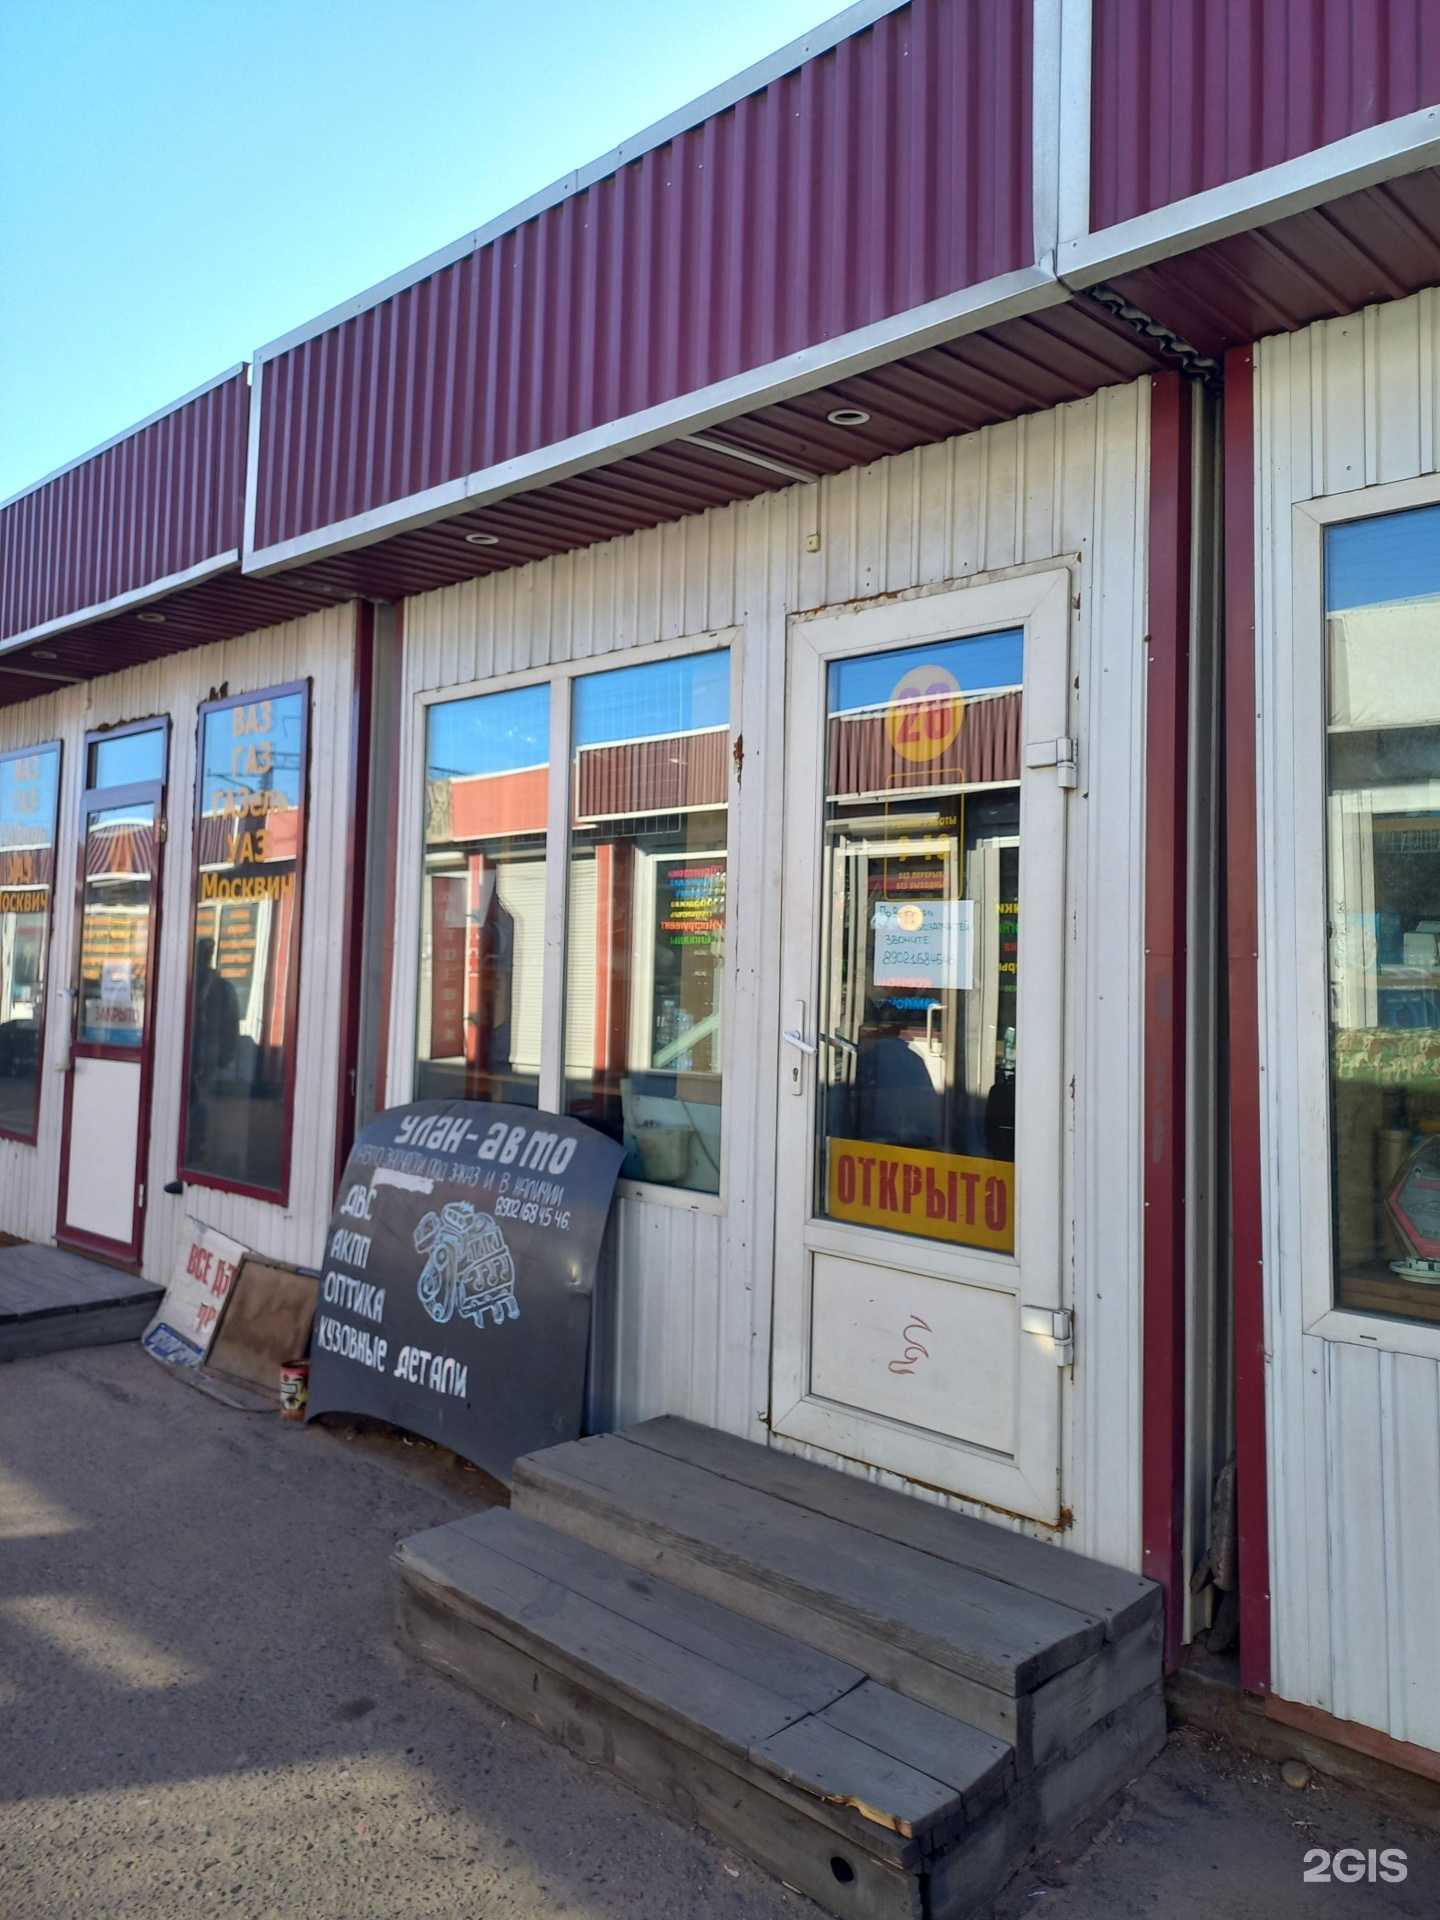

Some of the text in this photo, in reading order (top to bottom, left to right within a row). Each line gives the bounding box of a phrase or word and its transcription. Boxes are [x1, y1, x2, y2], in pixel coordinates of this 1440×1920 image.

[232, 701, 272, 736] ВАЗ
[896, 683, 952, 743] 20
[231, 741, 272, 777] ГАЗ
[217, 829, 272, 865] УАЗ
[499, 1171, 512, 1193] В
[837, 1154, 1008, 1232] ОТКРЫТО
[340, 1184, 377, 1220] ДВС
[187, 1242, 213, 1285] ВСЕ
[330, 1229, 372, 1269] АКПП
[323, 1272, 386, 1323] ОПТИКА
